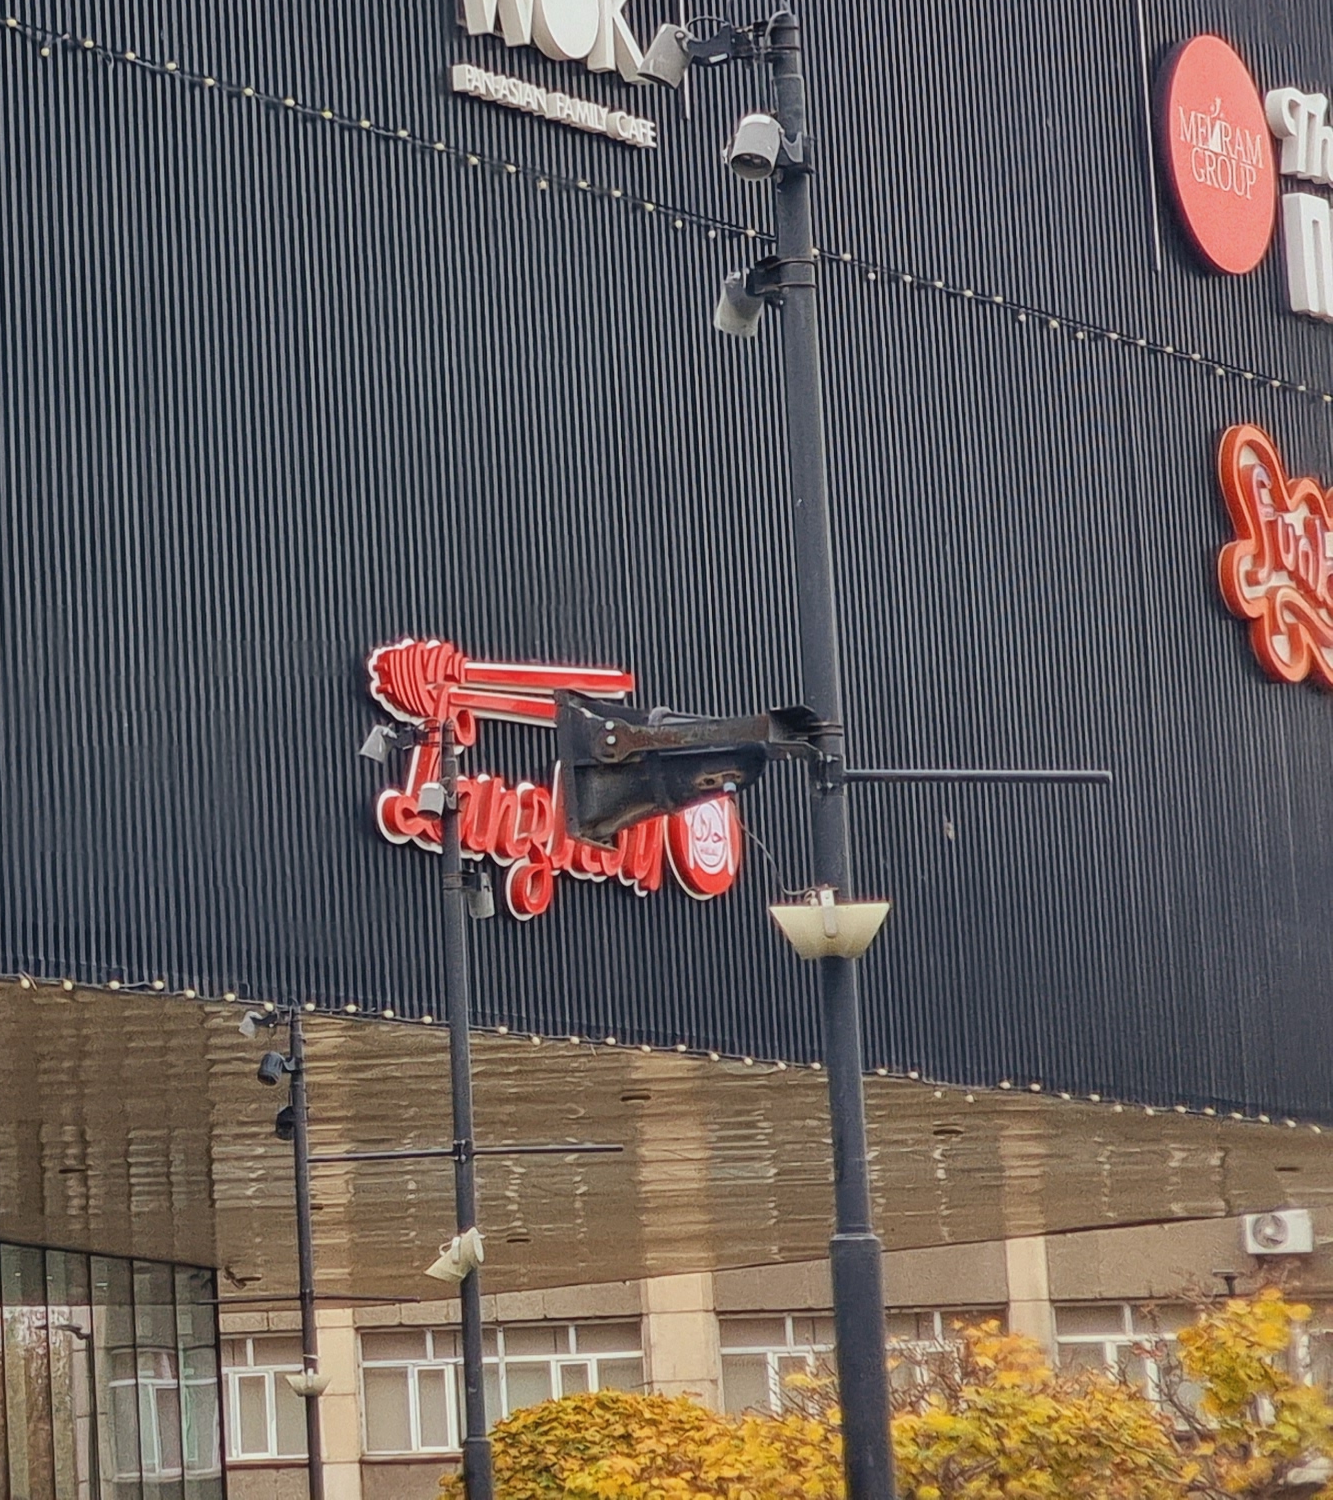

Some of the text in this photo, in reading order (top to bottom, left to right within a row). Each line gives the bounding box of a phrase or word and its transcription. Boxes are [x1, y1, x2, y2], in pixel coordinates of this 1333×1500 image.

[452, 64, 658, 148] PAN-ASIAN FAMILY CAFE
[1191, 147, 1257, 200] GROUP
